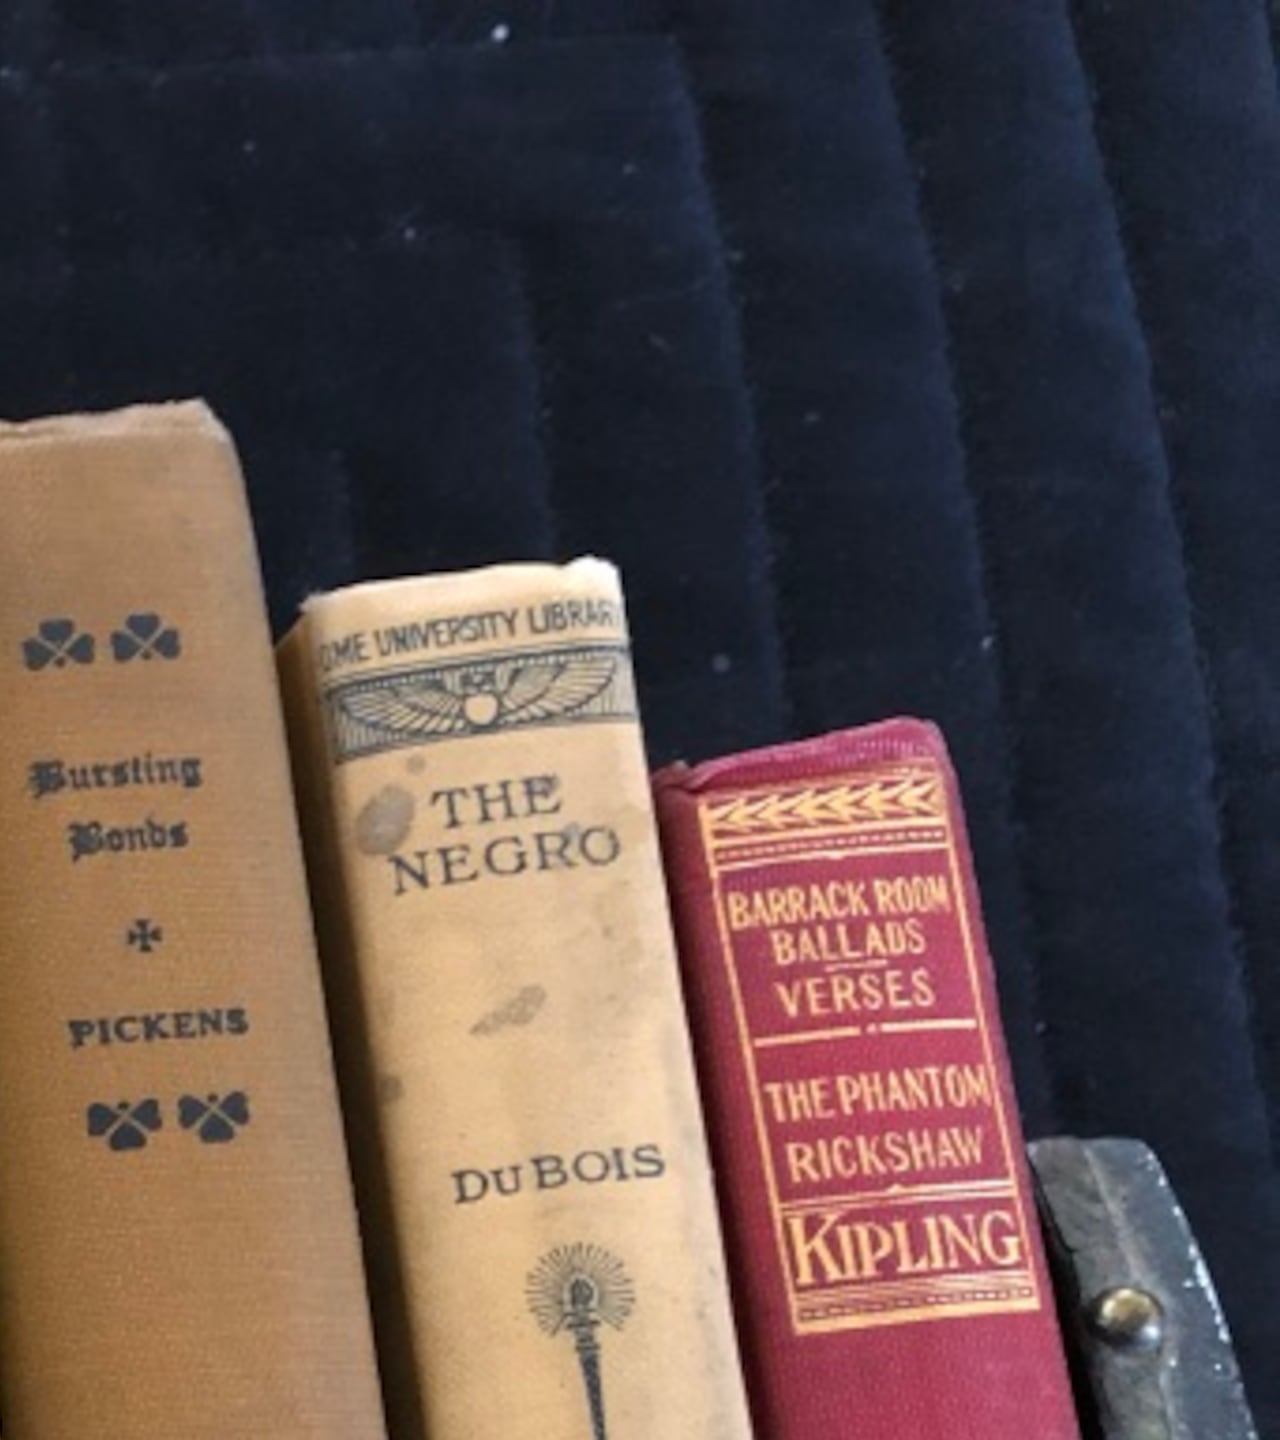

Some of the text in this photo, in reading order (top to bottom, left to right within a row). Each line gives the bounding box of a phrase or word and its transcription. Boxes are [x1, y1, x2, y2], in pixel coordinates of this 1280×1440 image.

[374, 608, 519, 656] UNIVERSITY
[527, 597, 618, 634] LIBRAR
[29, 752, 202, 799] Bursting
[430, 775, 561, 829] THE
[68, 816, 189, 863] Bonds
[388, 824, 621, 897] NEGRO
[729, 876, 951, 931] BARRACK ROOM
[771, 919, 926, 966] BALLADS
[778, 968, 936, 1019] VERSES
[68, 1008, 248, 1049] PICKENS
[765, 1063, 992, 1123] THE PHANTOM
[786, 1126, 983, 1184] RICKSHAW
